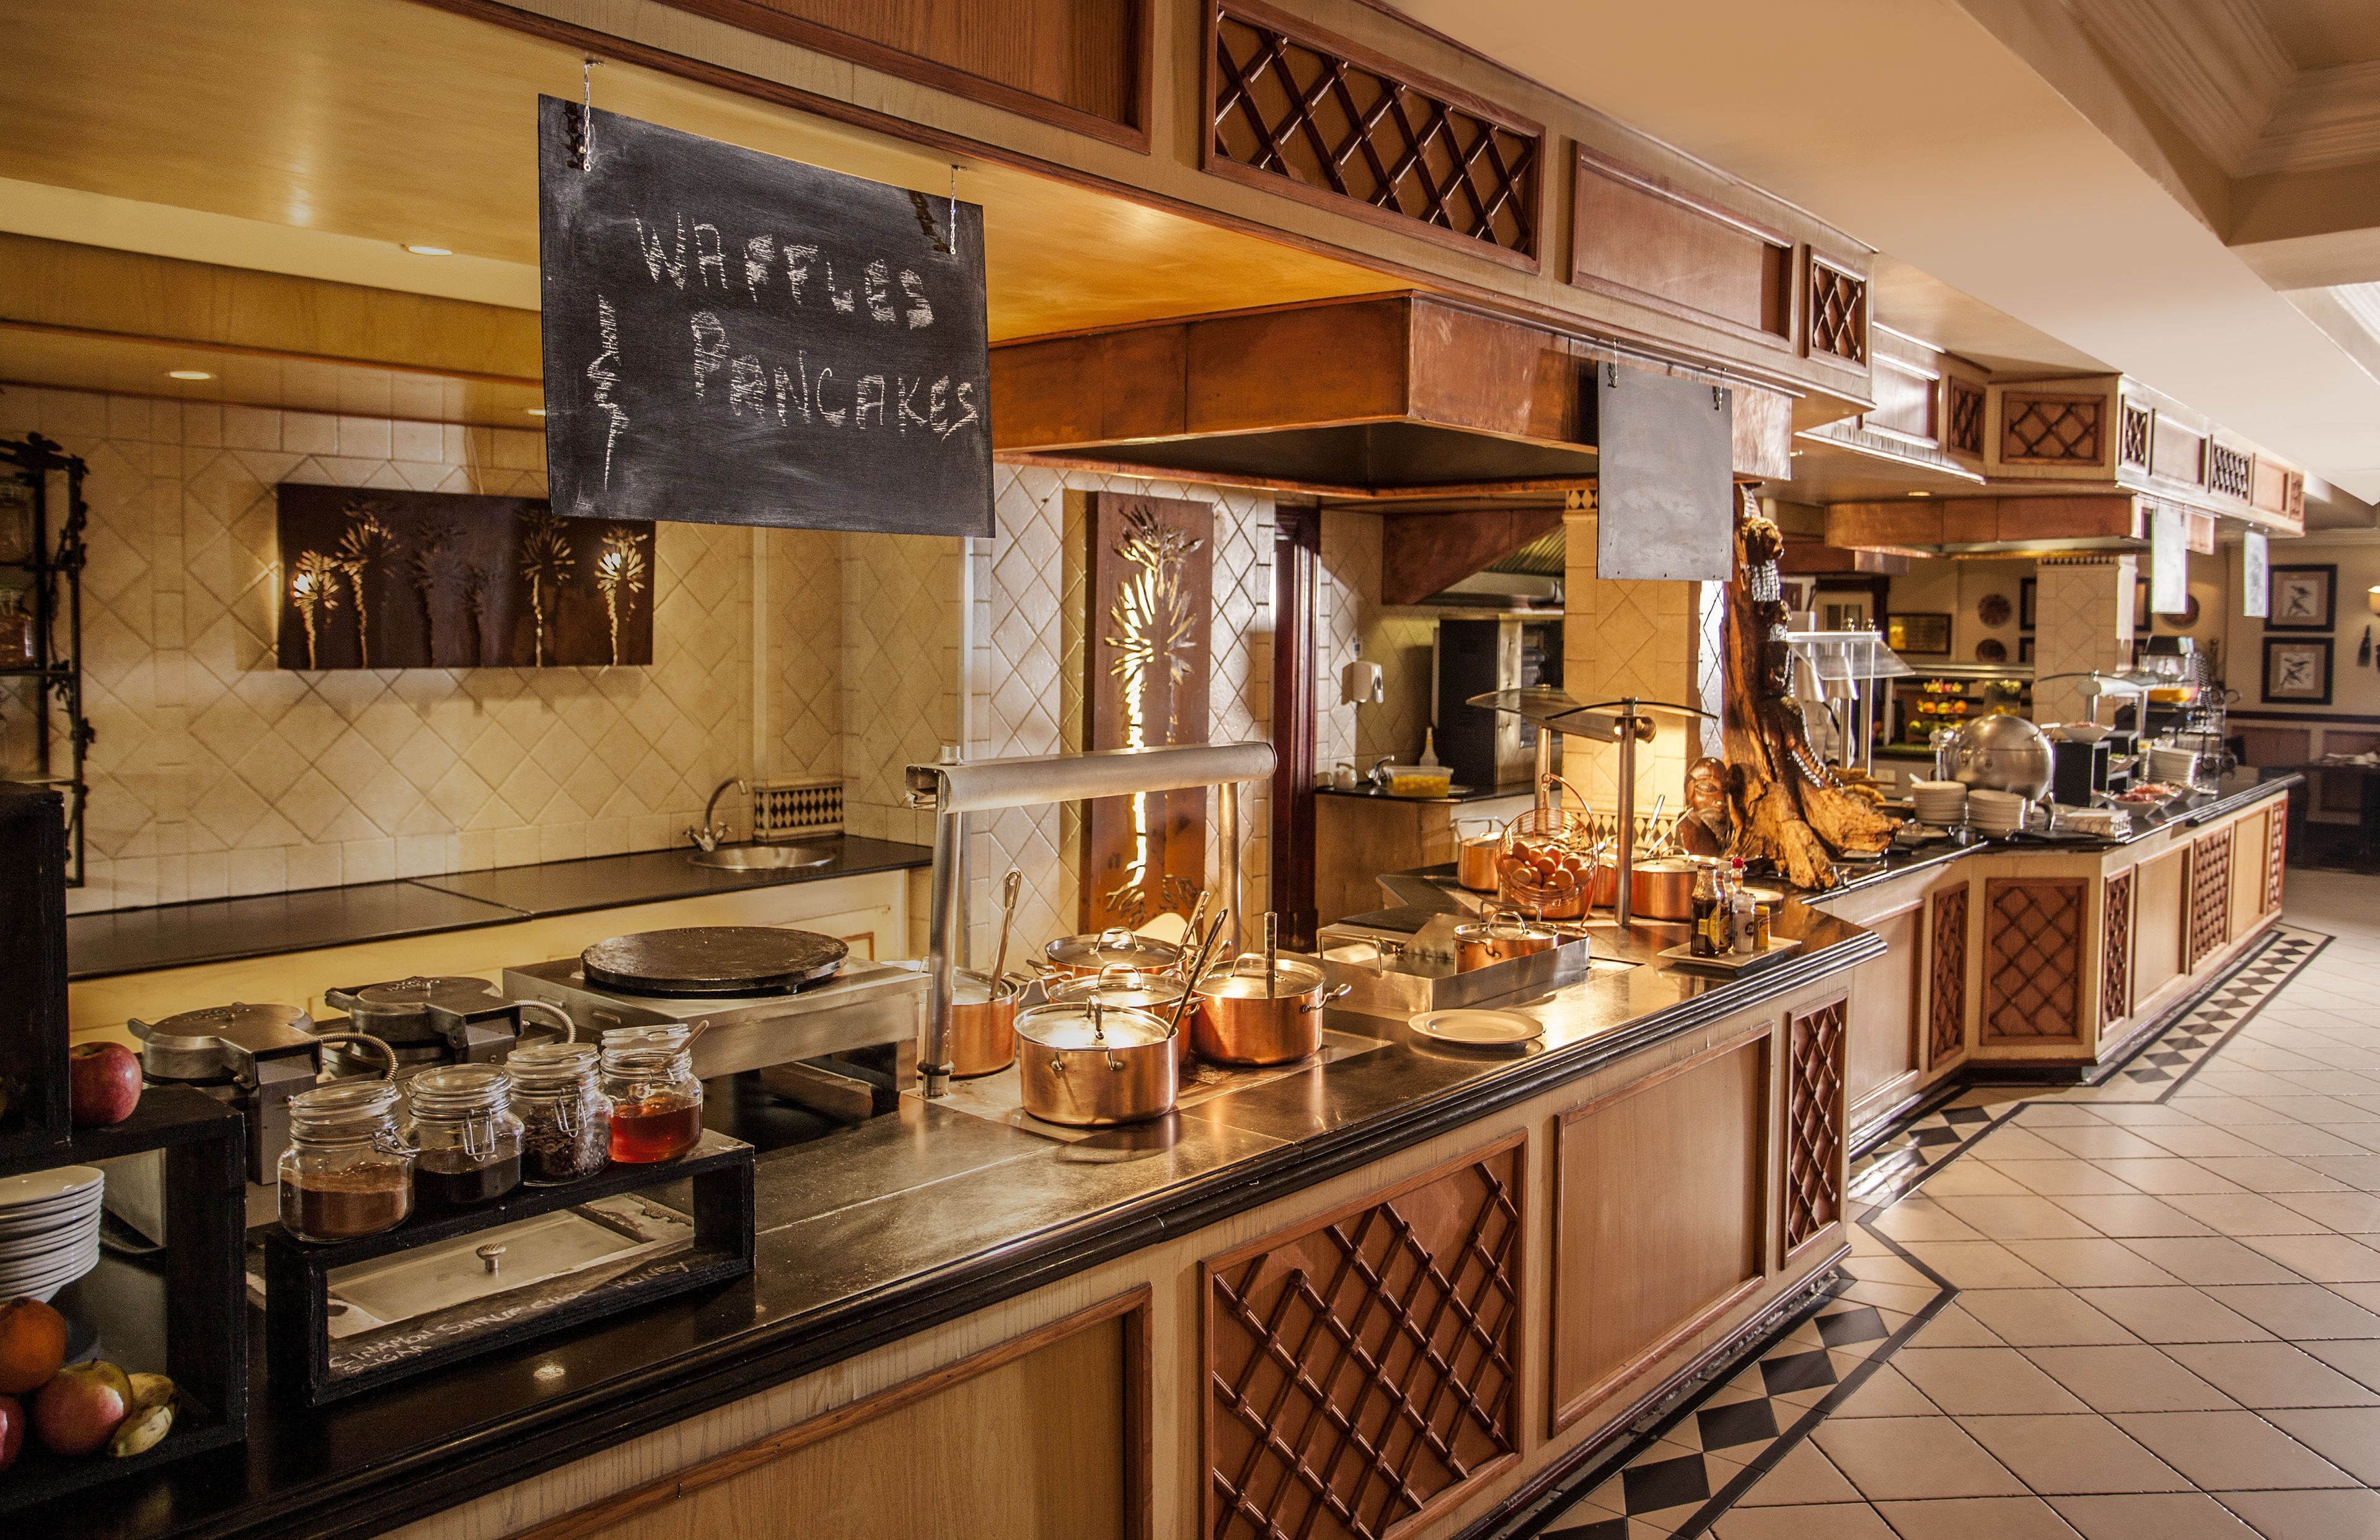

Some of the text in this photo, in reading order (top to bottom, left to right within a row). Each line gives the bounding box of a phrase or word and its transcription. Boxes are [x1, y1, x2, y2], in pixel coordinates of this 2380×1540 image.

[632, 204, 933, 330] WAFFLES
[690, 311, 979, 442] PANCAKES
[606, 1262, 689, 1289] HONEY
[344, 1345, 431, 1373] SUGAR
